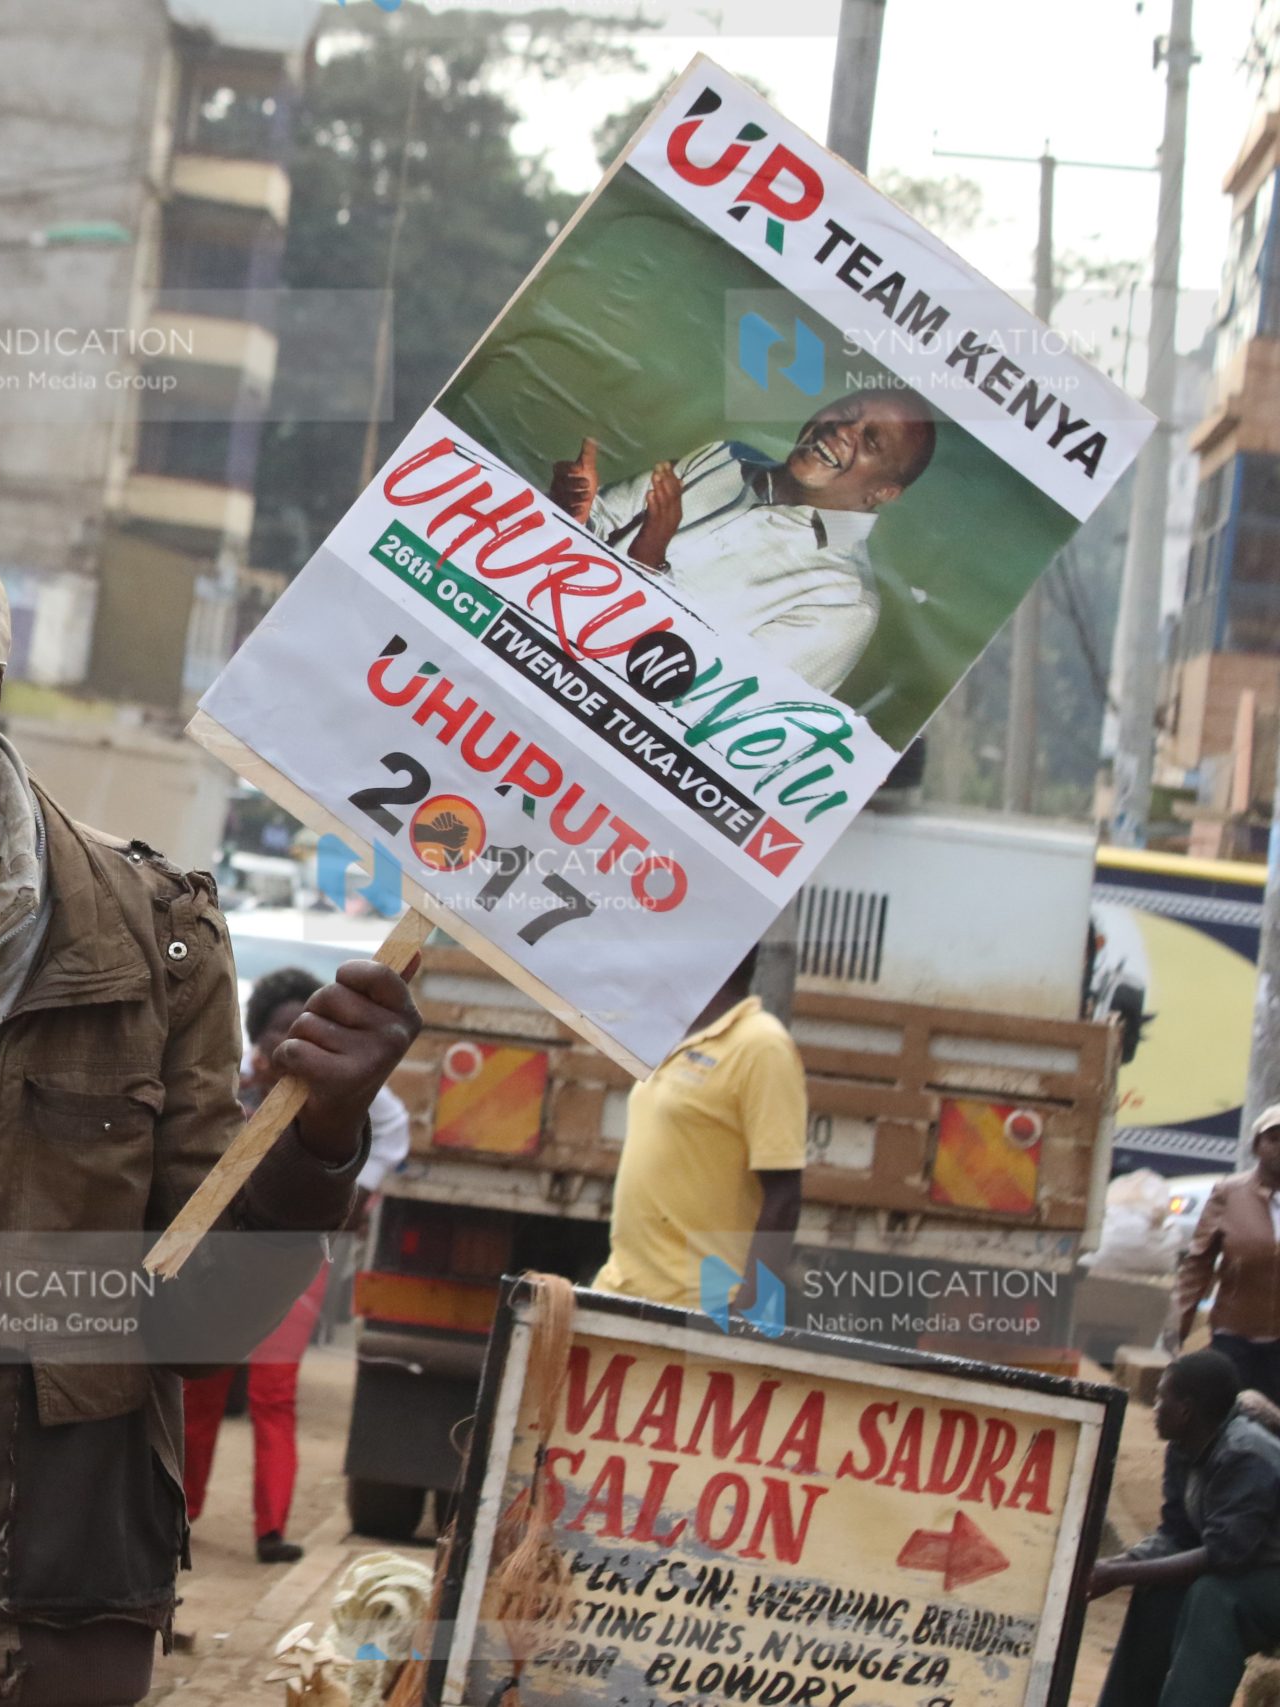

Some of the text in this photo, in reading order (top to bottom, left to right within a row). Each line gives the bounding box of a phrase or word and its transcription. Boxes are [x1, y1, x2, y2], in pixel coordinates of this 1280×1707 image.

[666, 85, 1109, 480] UR TEAM KENYA
[378, 533, 492, 624] 26th OCT
[383, 437, 855, 824] UHURU Ni Wetu
[367, 634, 688, 913] UHURUTO
[487, 619, 754, 834] TWENDE TUKA-VOTE
[508, 1446, 829, 1565] SALON
[530, 1346, 1058, 1515] MAMA SADRA
[644, 1650, 857, 1707] BLOWDRY
[759, 1630, 950, 1688] NYONGEZA
